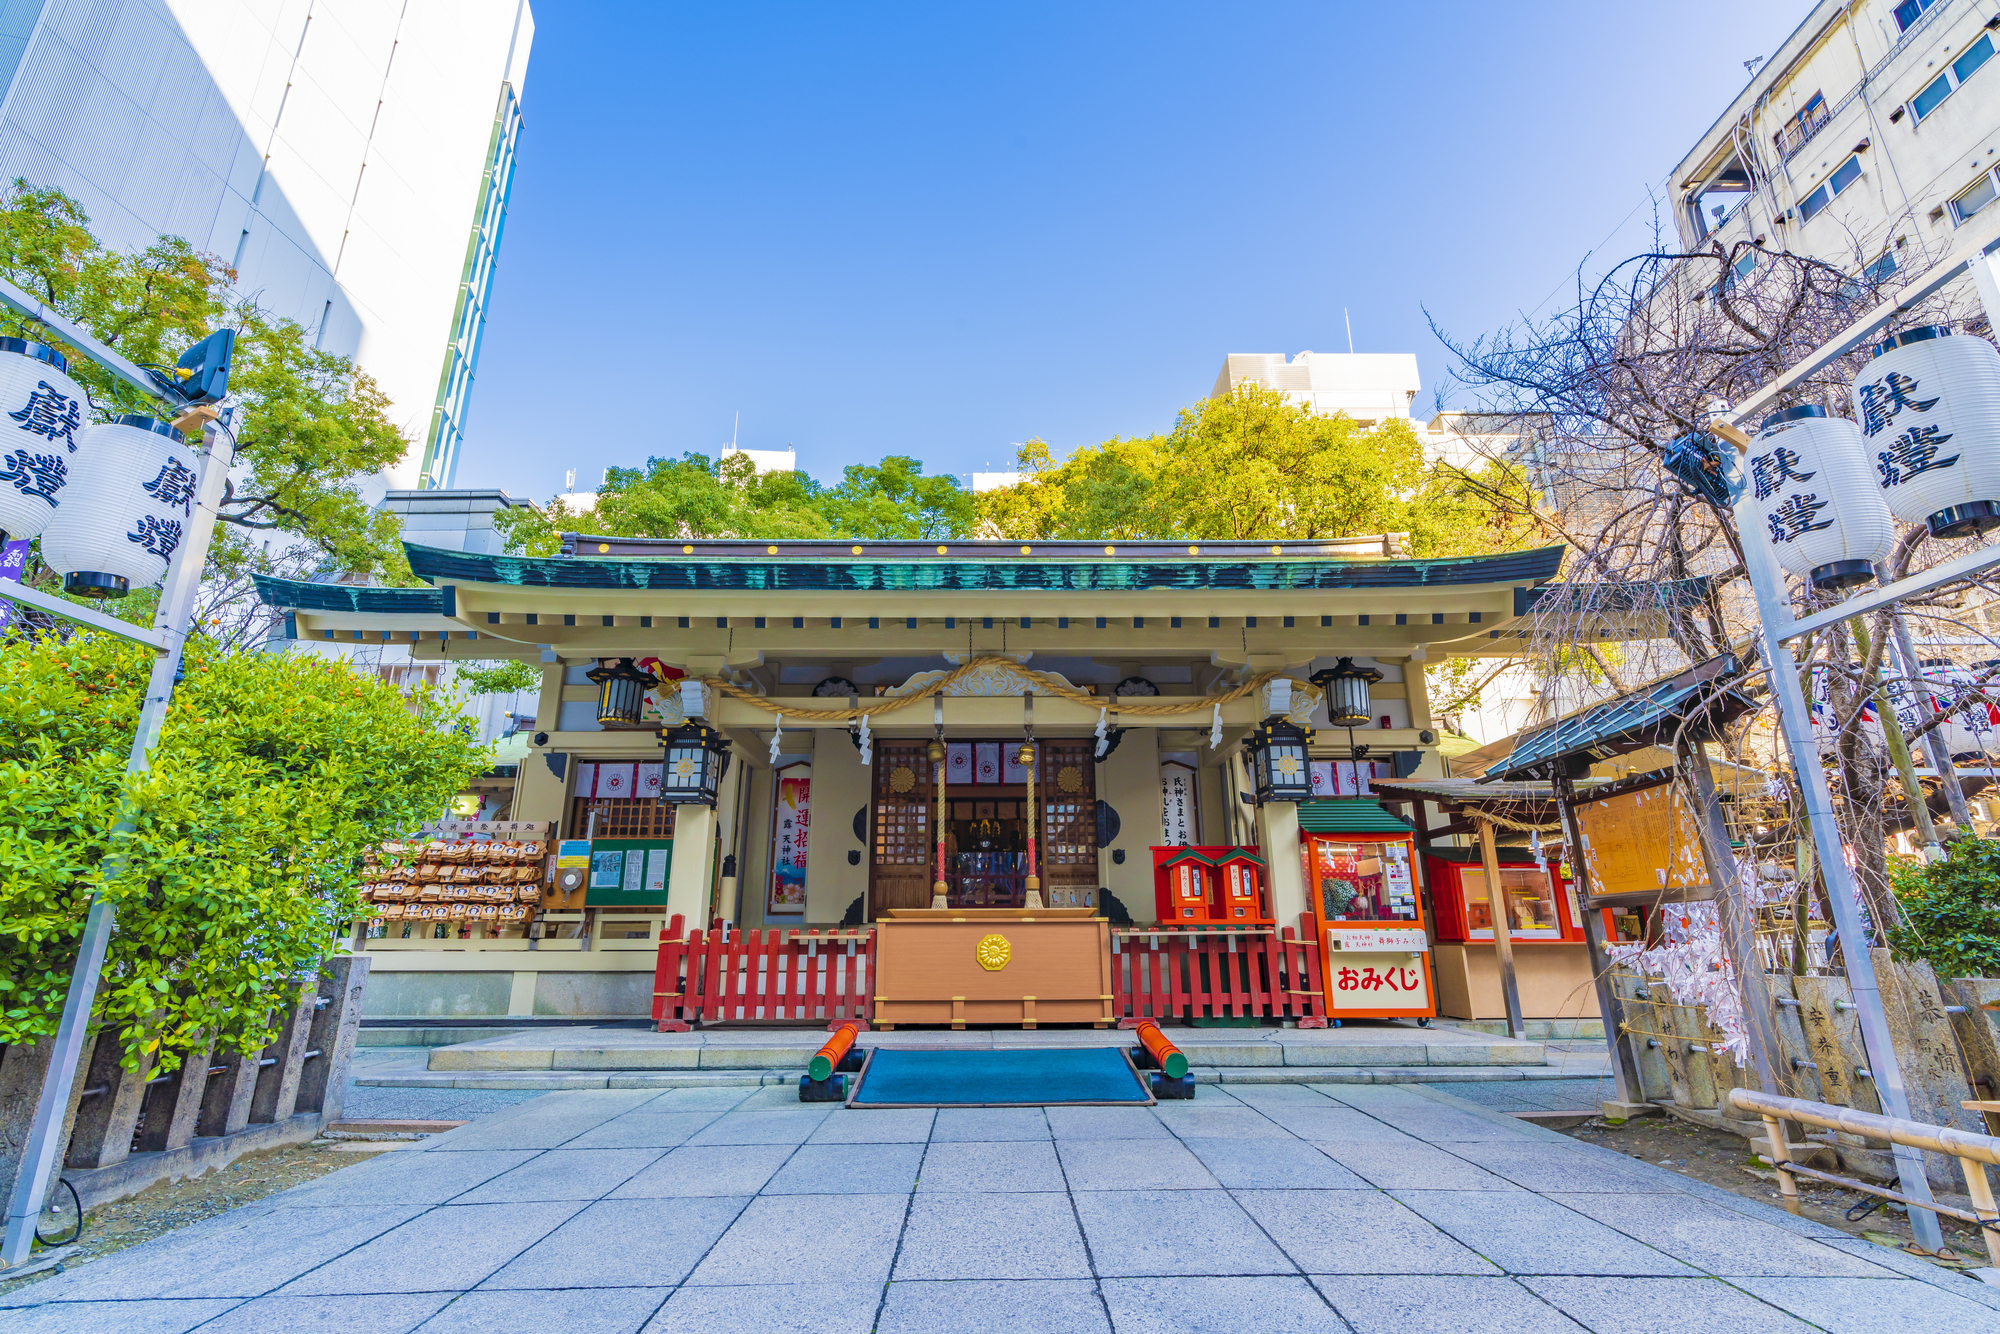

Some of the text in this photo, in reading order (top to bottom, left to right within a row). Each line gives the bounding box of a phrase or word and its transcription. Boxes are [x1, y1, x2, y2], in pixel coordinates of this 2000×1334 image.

[780, 818, 793, 867] 露天神社
[792, 786, 810, 870] 開運招福
[1337, 966, 1419, 992] おみくじ
